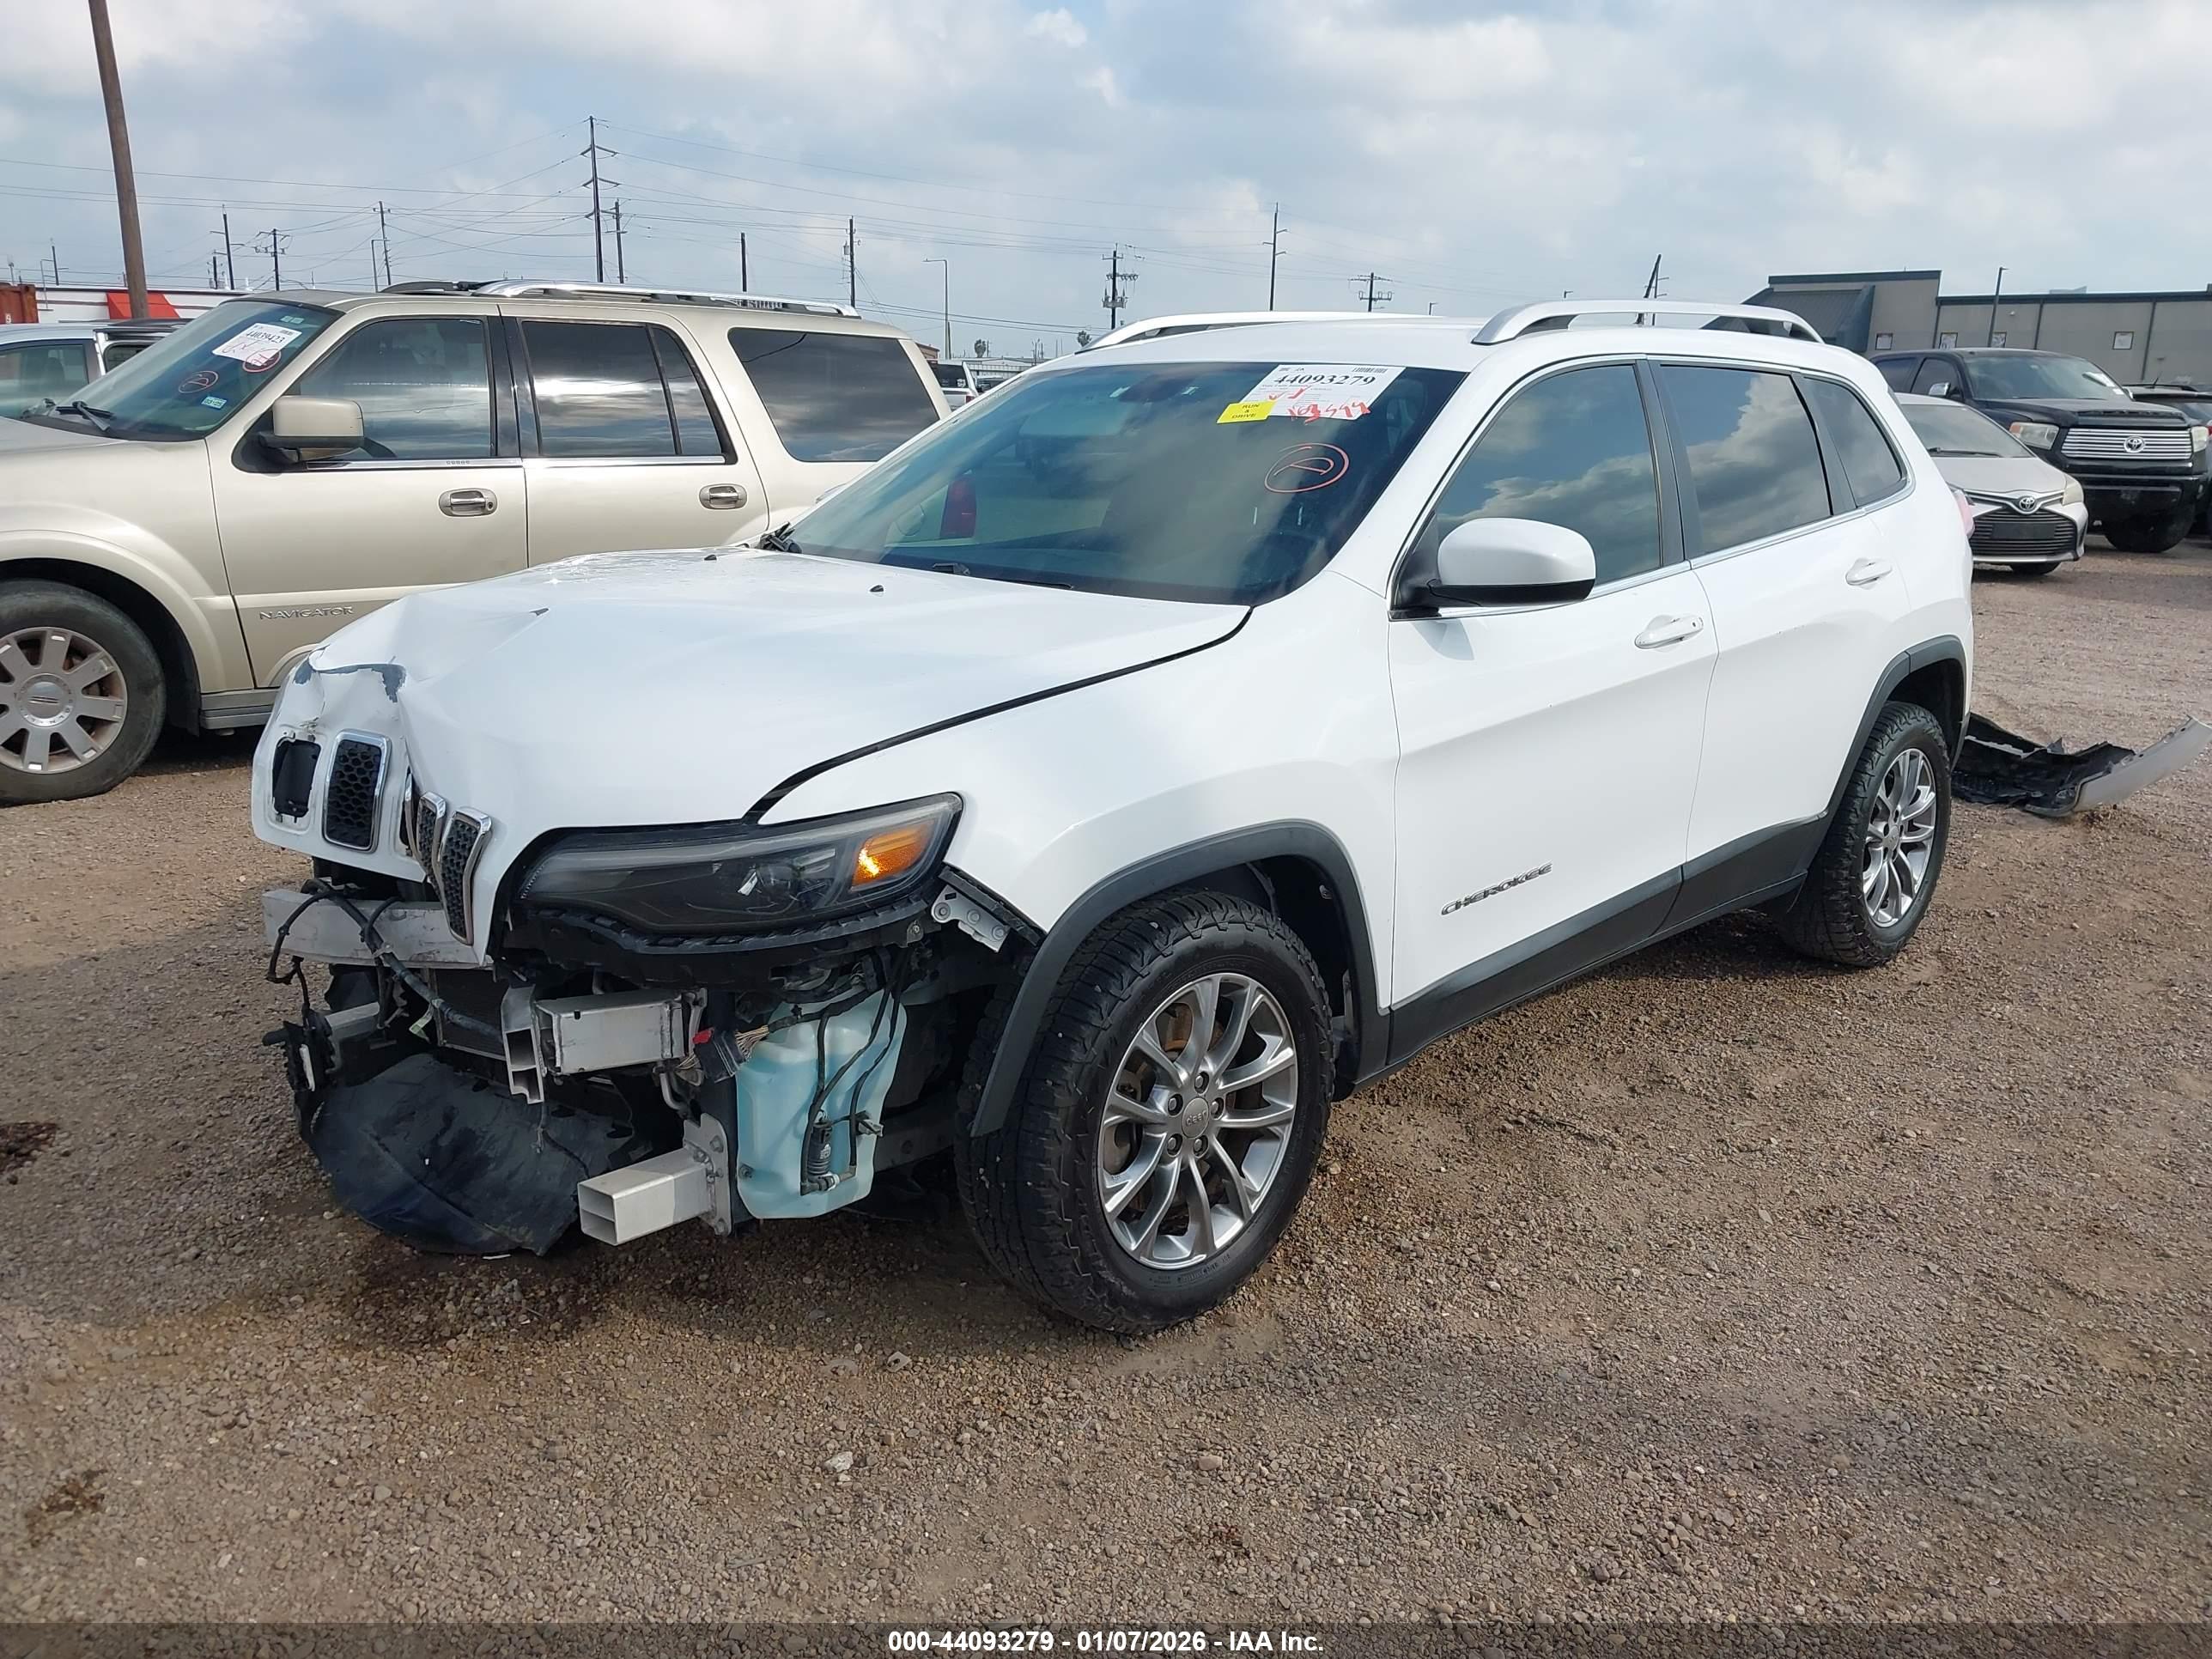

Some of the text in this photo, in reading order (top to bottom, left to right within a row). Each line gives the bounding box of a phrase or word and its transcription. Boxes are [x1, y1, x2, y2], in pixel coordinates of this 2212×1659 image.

[1274, 374, 1376, 386] 44093279
[259, 606, 354, 619] NAVIGATOR
[1441, 863, 1553, 915] CHEROKEE
